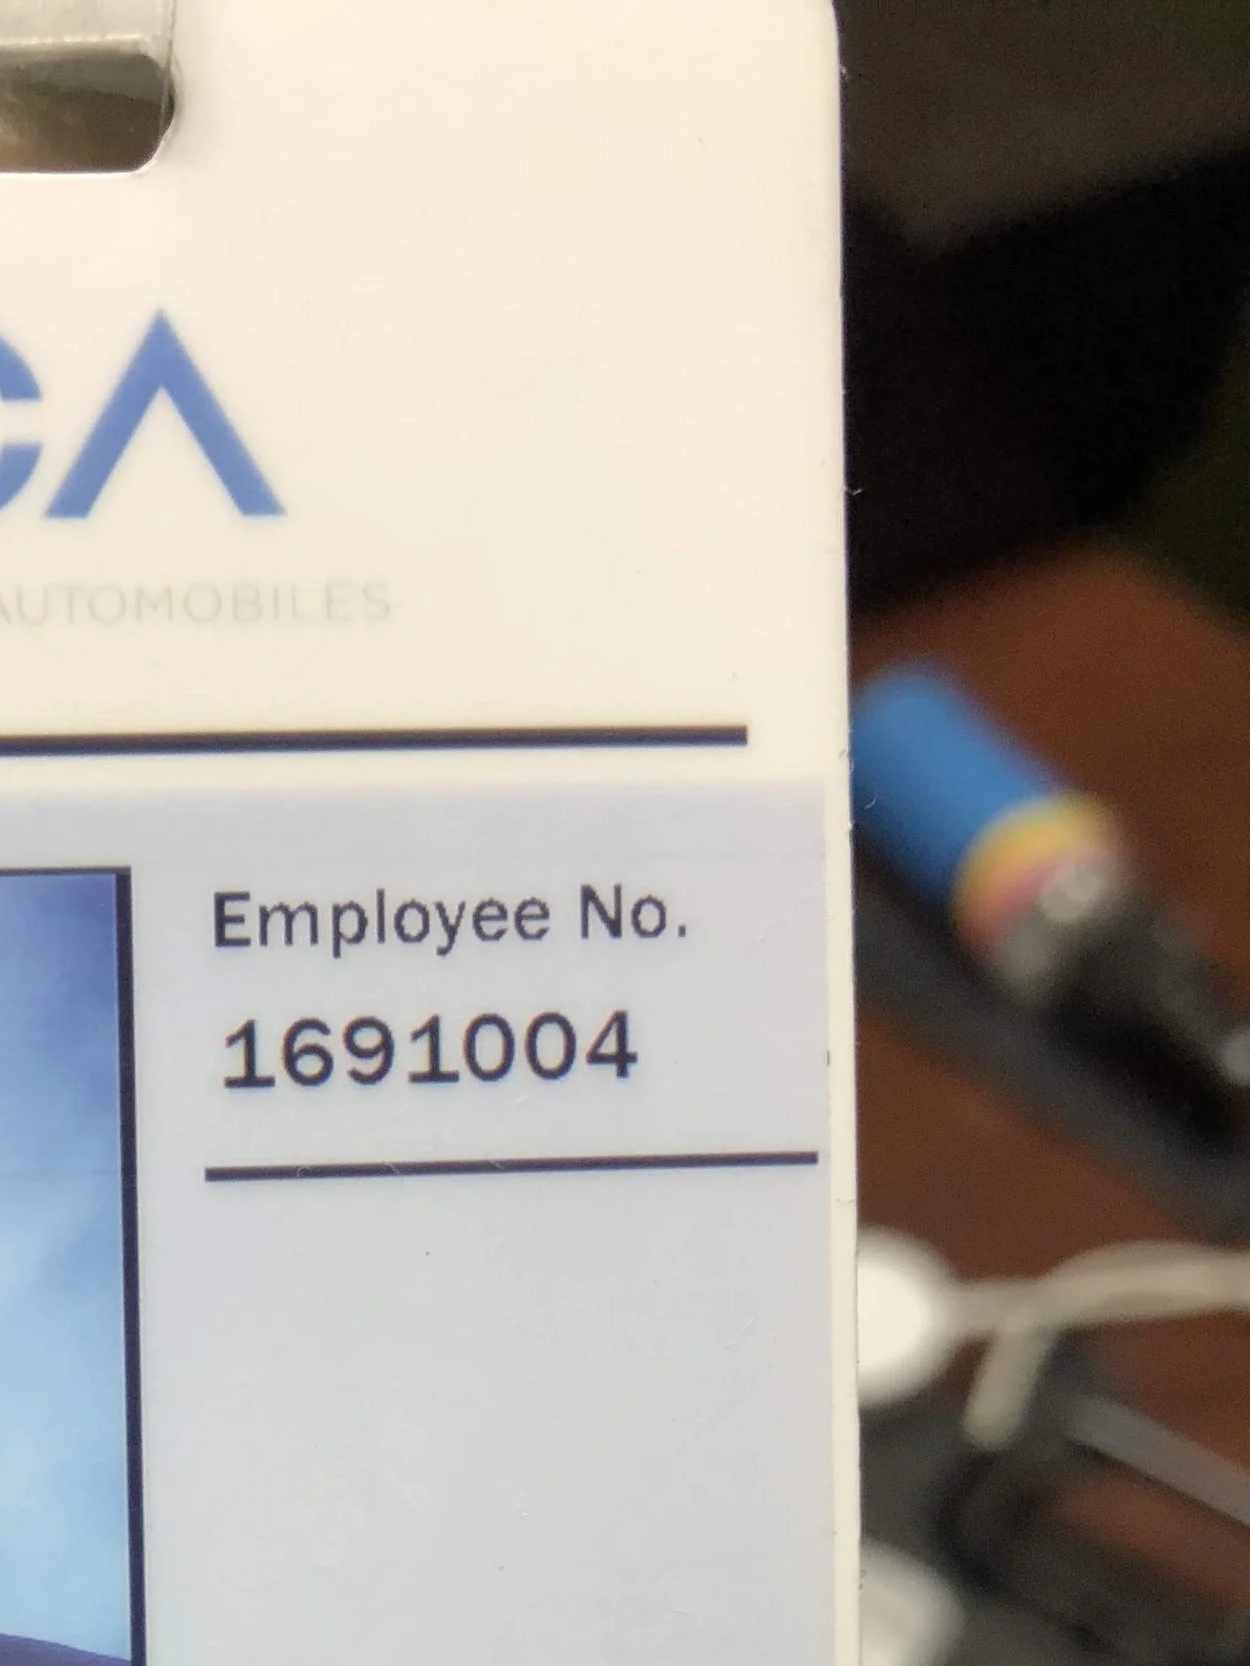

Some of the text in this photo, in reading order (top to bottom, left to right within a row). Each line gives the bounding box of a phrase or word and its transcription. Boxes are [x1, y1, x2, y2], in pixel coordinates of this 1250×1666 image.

[214, 884, 687, 958] Employee No.
[224, 1010, 637, 1089] 1691004
